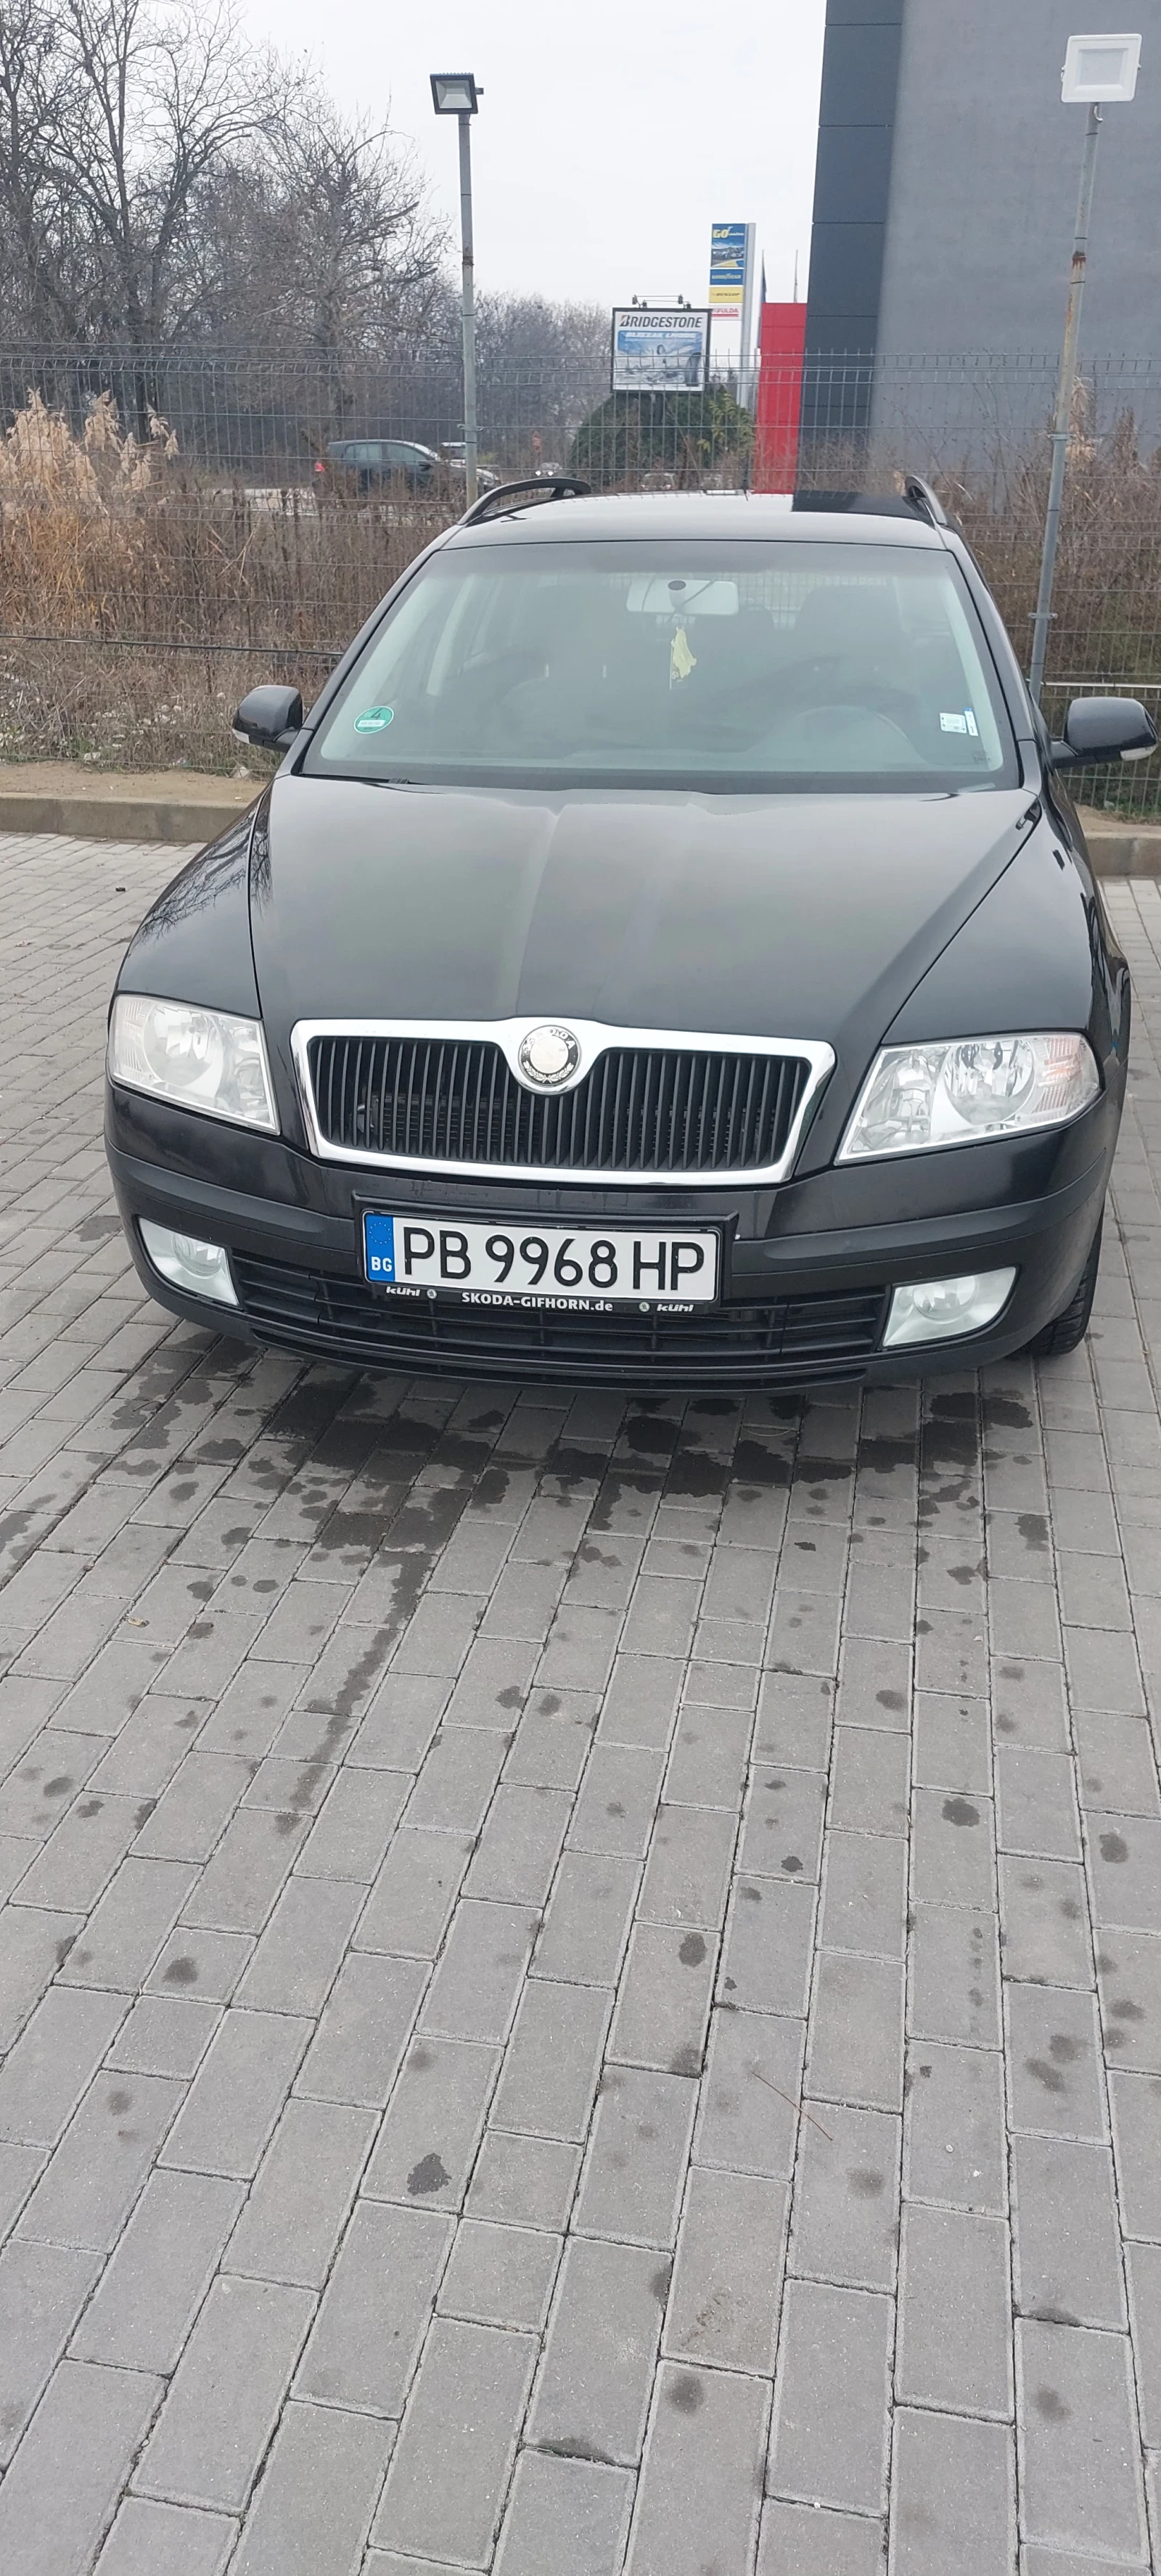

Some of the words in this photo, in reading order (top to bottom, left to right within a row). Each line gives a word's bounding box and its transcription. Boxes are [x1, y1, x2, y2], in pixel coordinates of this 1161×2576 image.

[619, 314, 703, 328] BRIDGESTONE
[371, 1256, 393, 1272] BG
[403, 1226, 471, 1279] PB
[485, 1234, 618, 1288] 9968
[633, 1241, 705, 1291] HP
[461, 1292, 613, 1311] SKODA-GIFHORN.de
